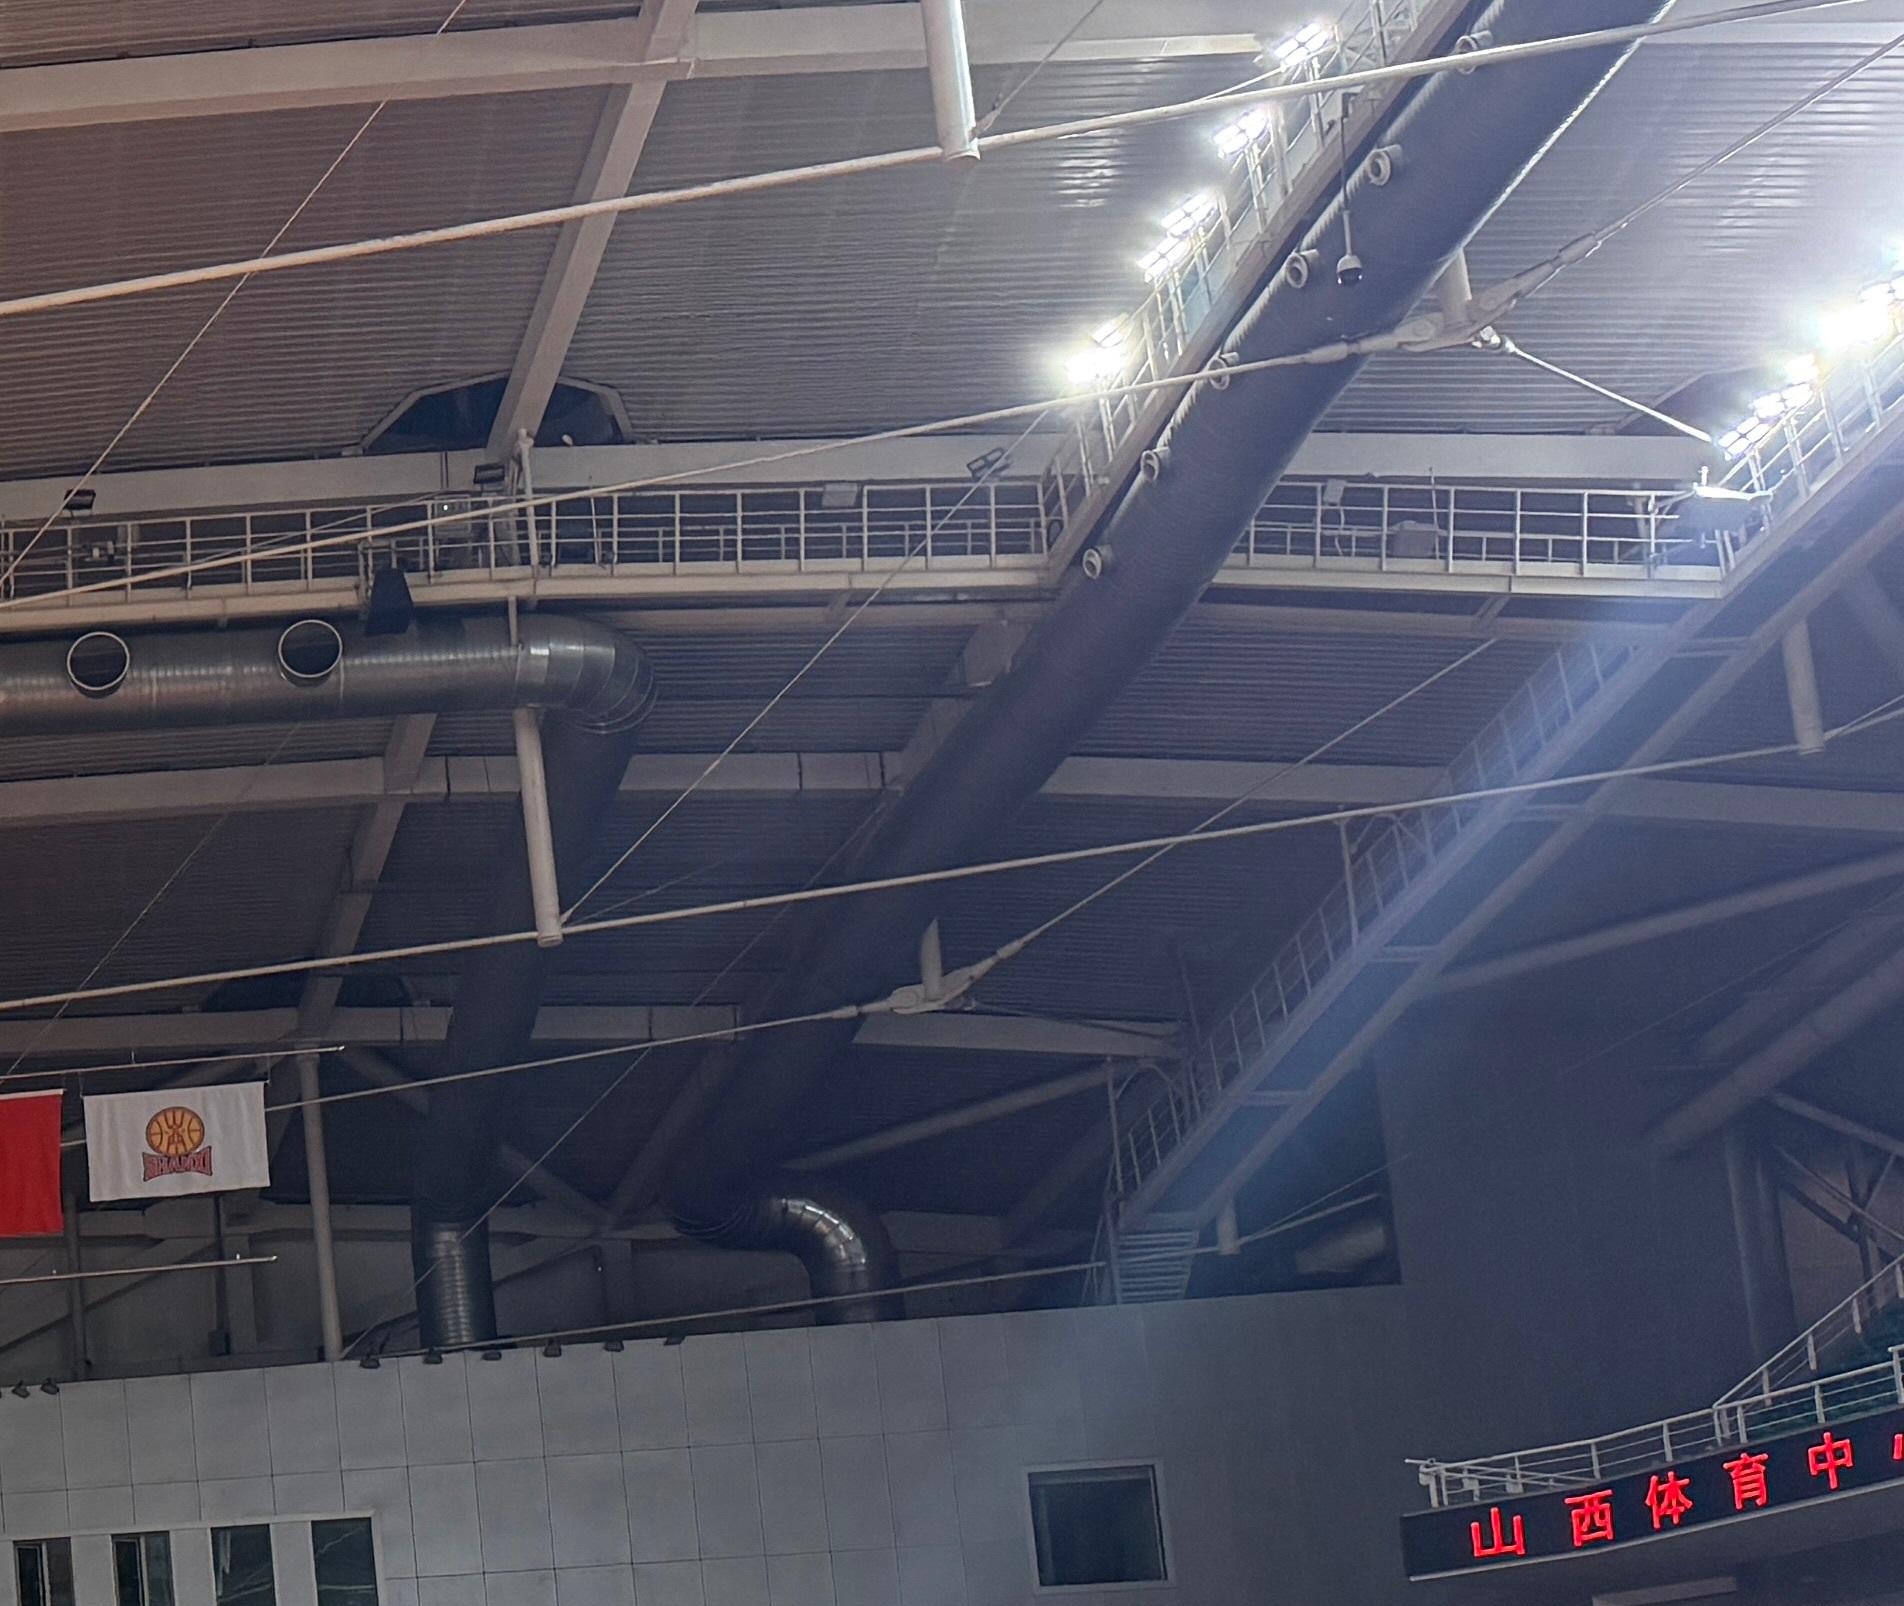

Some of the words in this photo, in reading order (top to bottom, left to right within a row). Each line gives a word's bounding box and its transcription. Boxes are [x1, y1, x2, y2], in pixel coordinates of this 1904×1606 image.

[1471, 1431, 1904, 1557] 山西体育中
